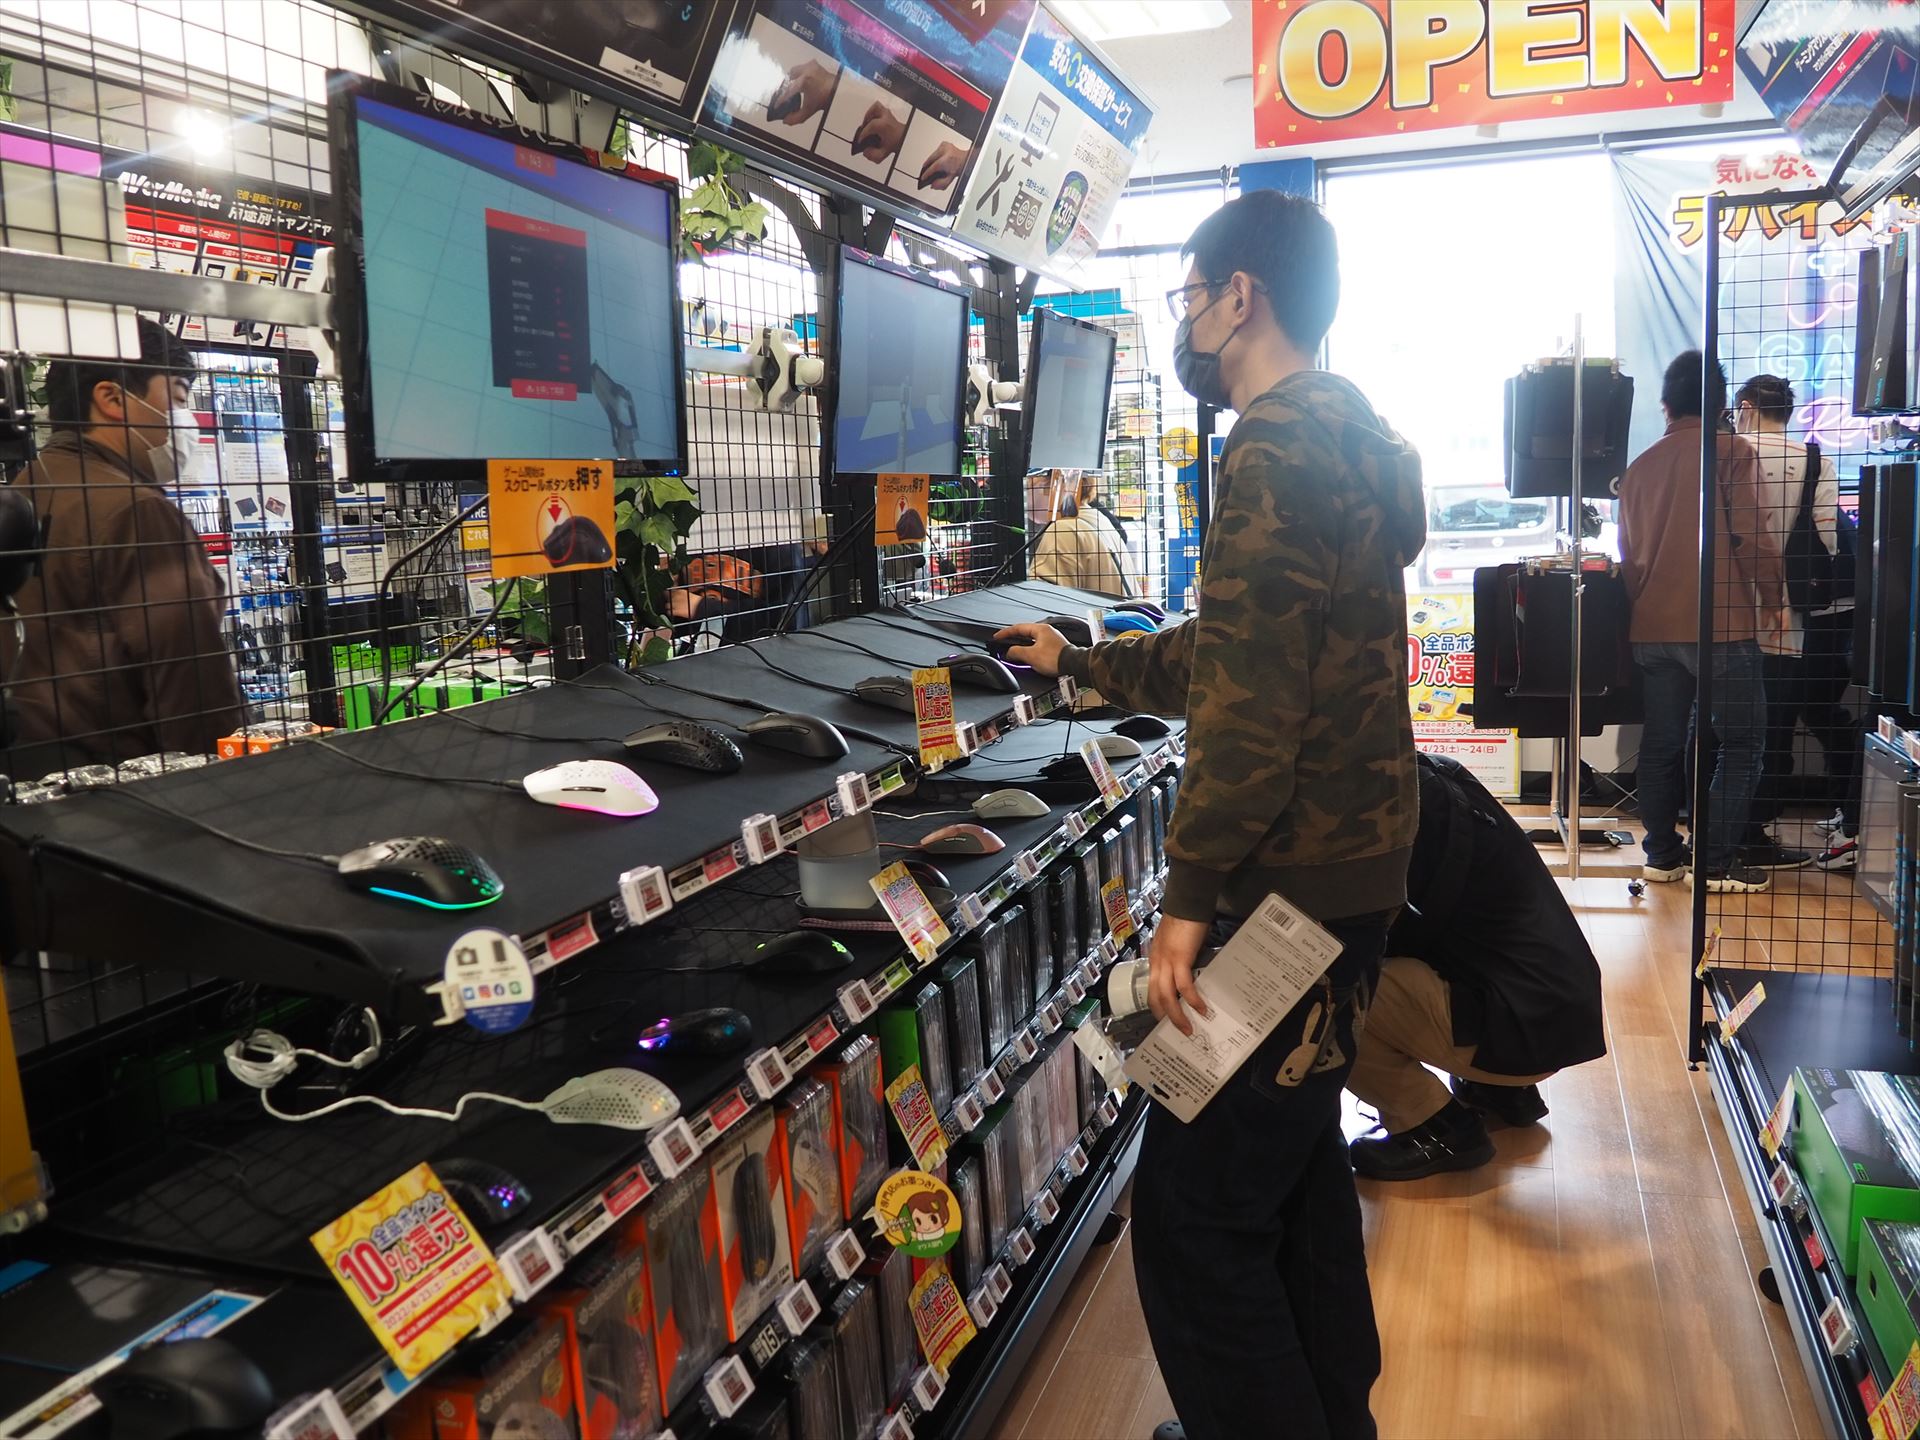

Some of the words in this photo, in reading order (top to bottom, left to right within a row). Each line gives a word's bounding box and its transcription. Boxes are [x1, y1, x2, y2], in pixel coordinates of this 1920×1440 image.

[1278, 0, 1704, 121] OPEN
[1425, 635, 1475, 651] 全品ポ
[371, 1192, 444, 1245] 全品ポイント
[338, 1209, 466, 1303] 10%還元
